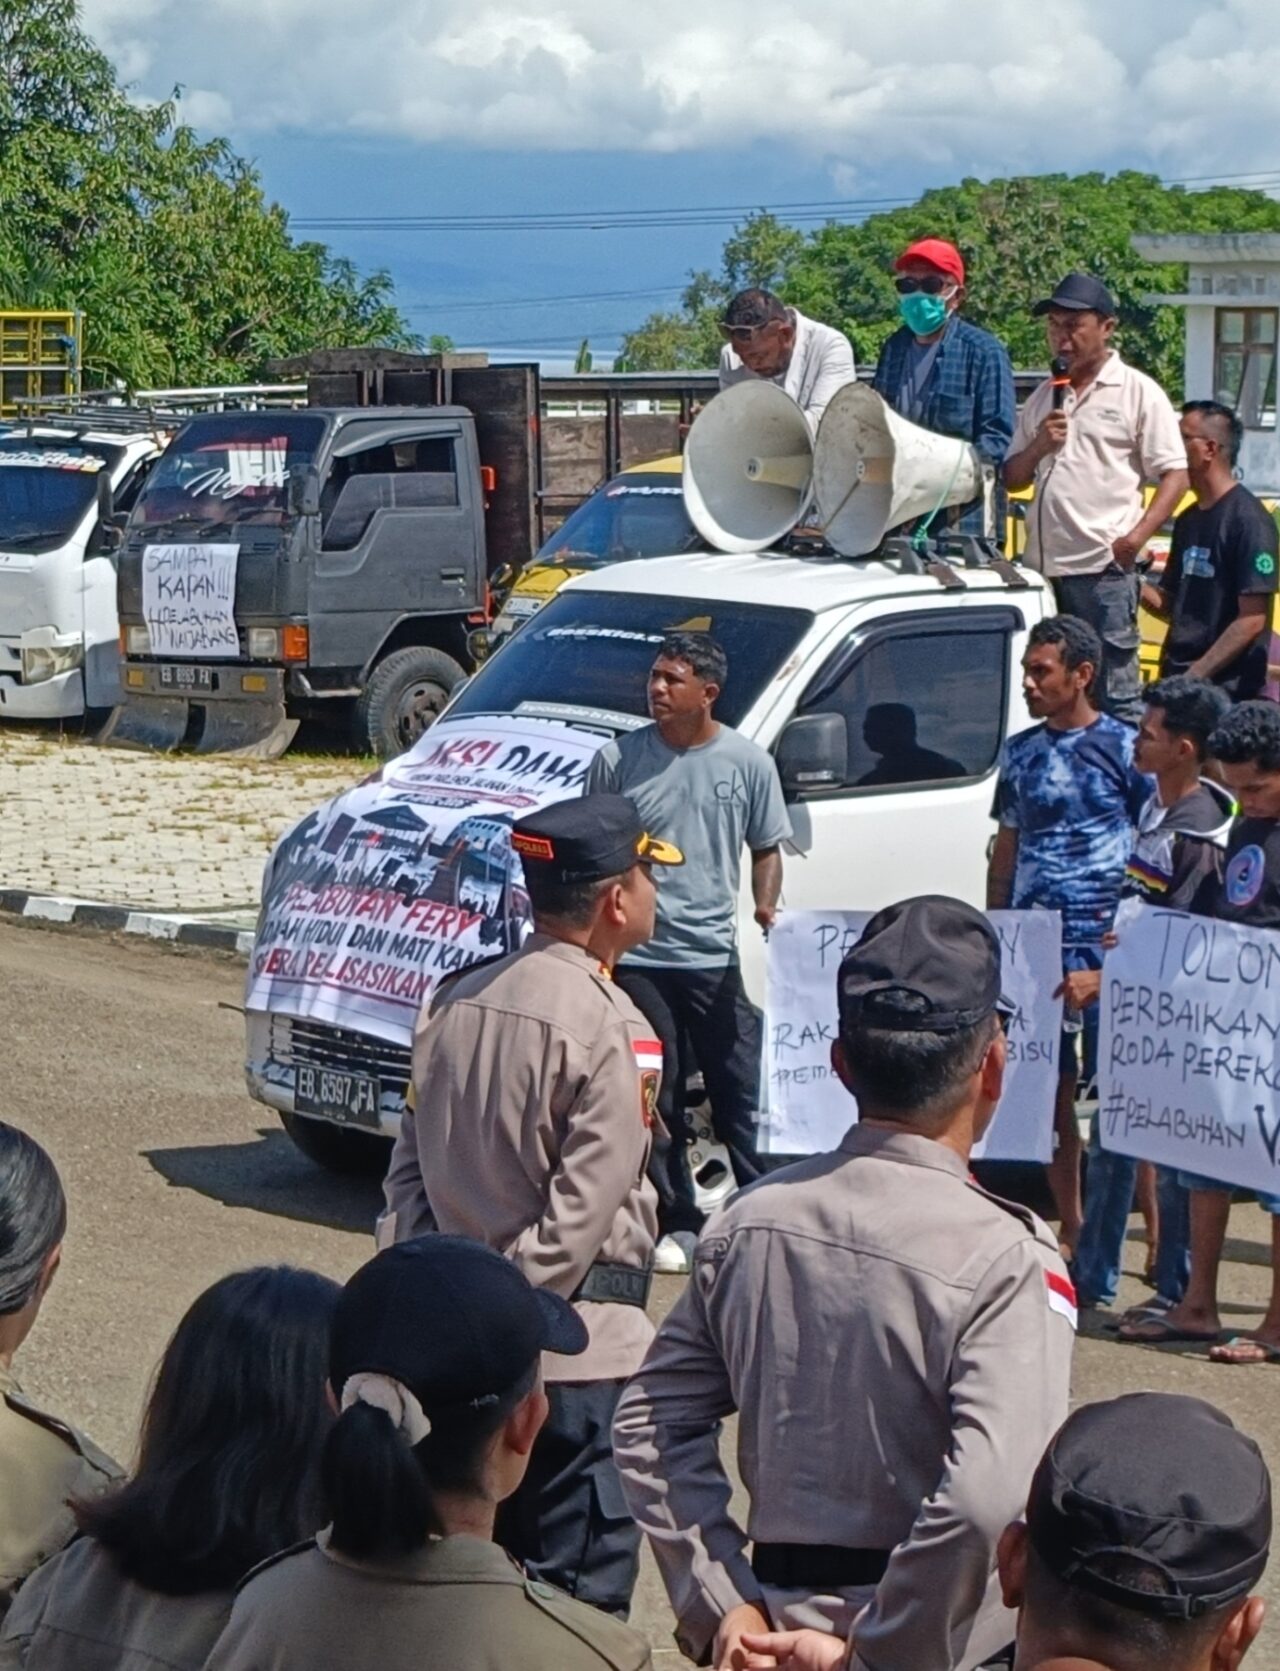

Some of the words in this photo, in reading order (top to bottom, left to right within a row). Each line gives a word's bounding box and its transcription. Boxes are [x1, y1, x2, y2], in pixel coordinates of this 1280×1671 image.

[401, 899, 485, 941] FERY
[347, 924, 388, 954] DAN
[390, 935, 436, 964] MATI
[1109, 1033, 1175, 1075] RODA
[298, 1067, 315, 1099] EB
[1103, 1079, 1246, 1148] #PELABUHAN
